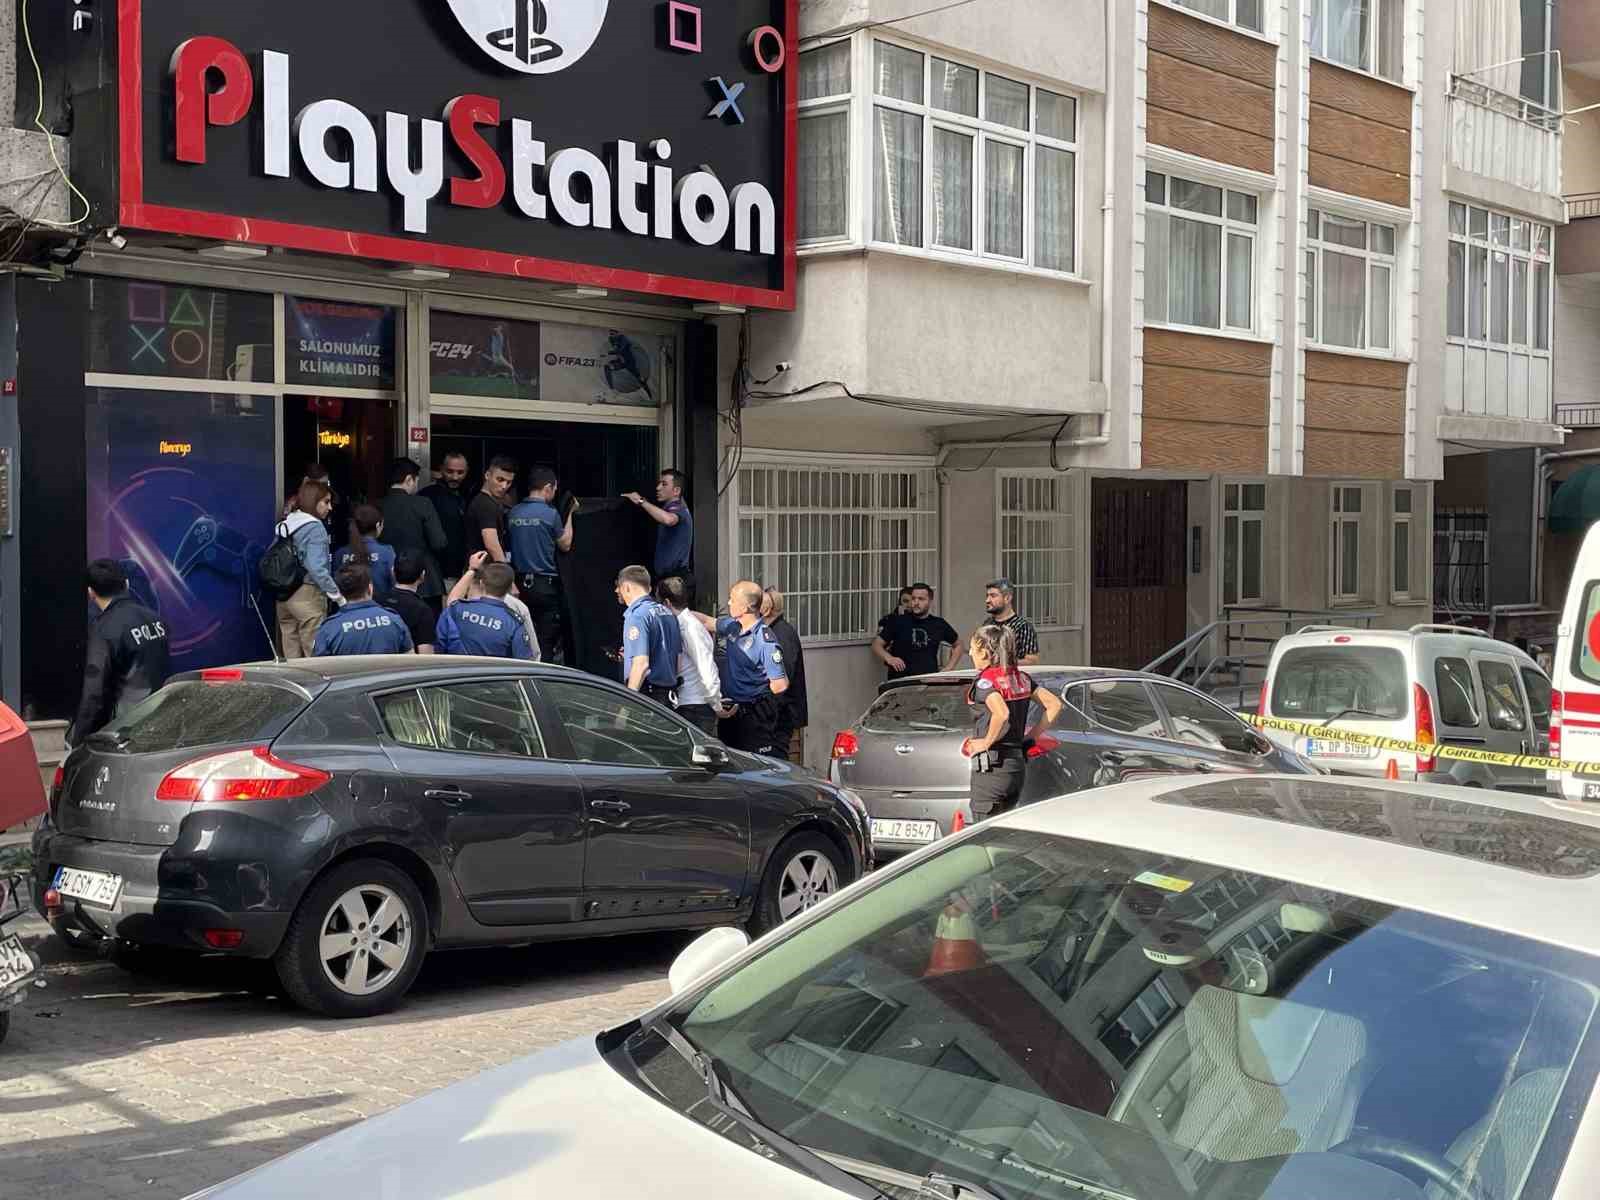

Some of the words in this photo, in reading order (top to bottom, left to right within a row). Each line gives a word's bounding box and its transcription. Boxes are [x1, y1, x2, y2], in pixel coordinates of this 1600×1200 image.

[171, 36, 776, 254] PlayStation
[300, 340, 380, 357] SALONUMUZ
[342, 615, 391, 632] POLIS
[462, 611, 503, 630] POLIS
